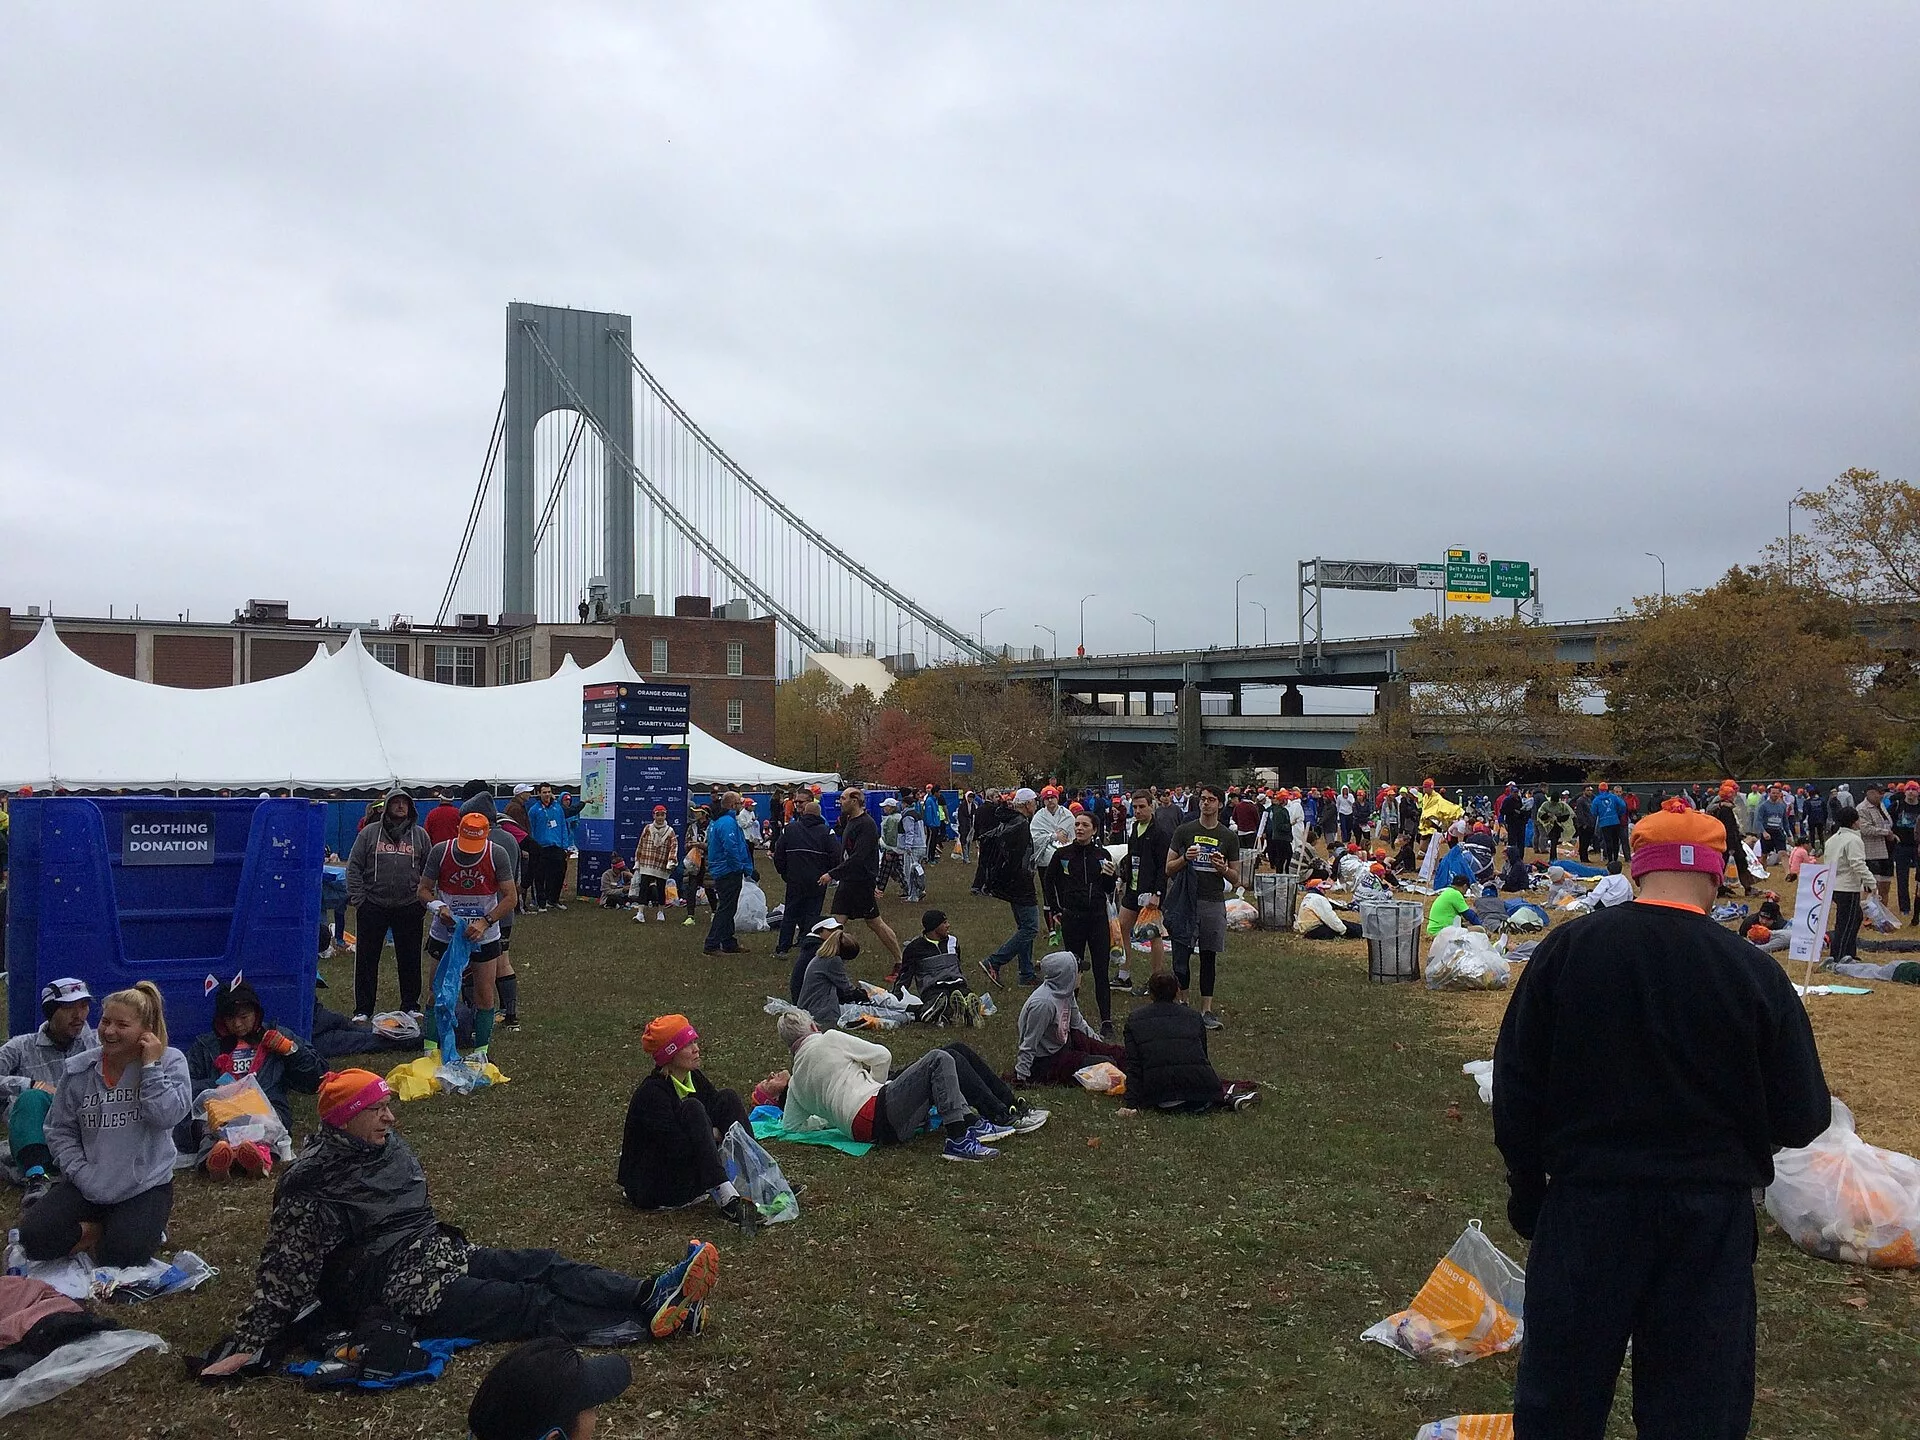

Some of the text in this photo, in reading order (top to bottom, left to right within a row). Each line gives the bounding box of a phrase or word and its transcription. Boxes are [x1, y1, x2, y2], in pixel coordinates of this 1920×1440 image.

[130, 824, 208, 834] CLOTHING
[130, 841, 208, 851] DONATION
[450, 869, 485, 884] ITALIA
